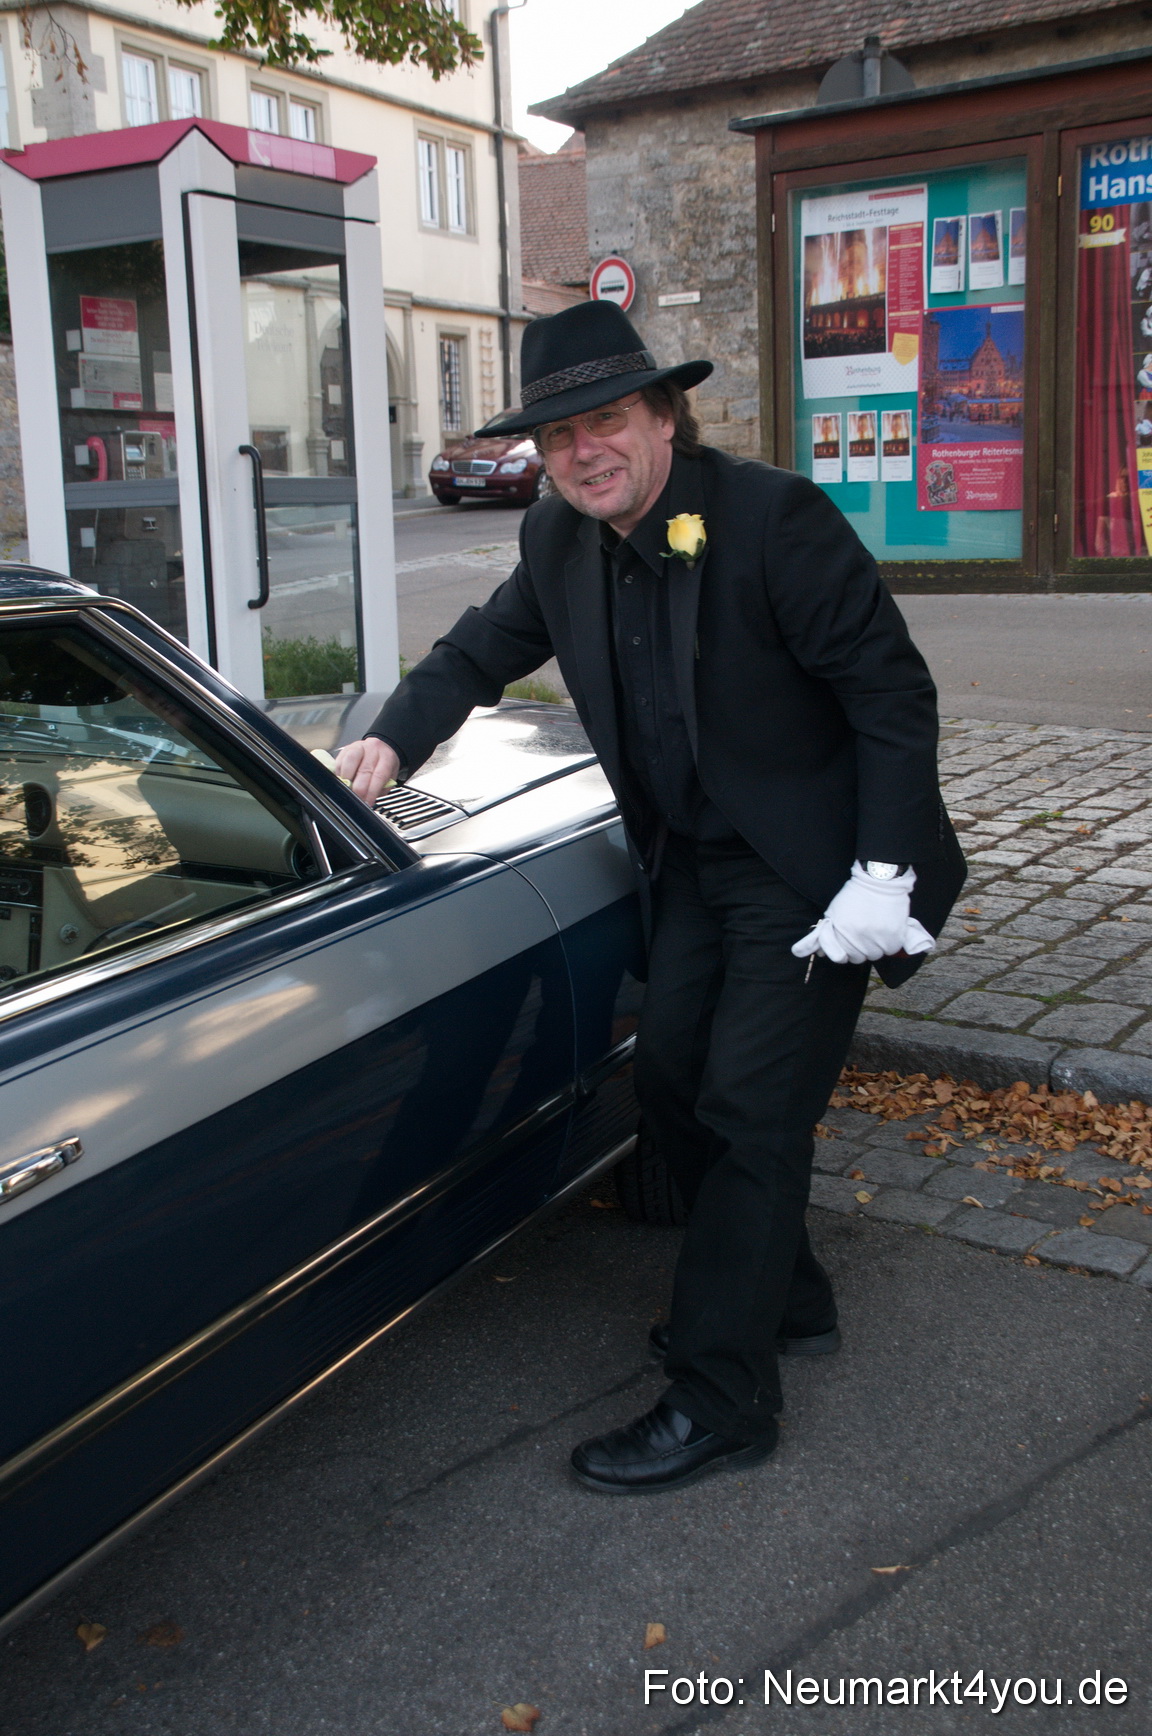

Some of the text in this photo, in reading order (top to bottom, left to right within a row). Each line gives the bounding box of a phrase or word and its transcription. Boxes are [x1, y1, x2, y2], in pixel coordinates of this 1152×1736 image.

[827, 207, 899, 222] Reichsstadt-Festtage
[1089, 213, 1115, 233] 90
[931, 448, 981, 458] Rothenburger
[964, 490, 998, 500] Rothenburg
